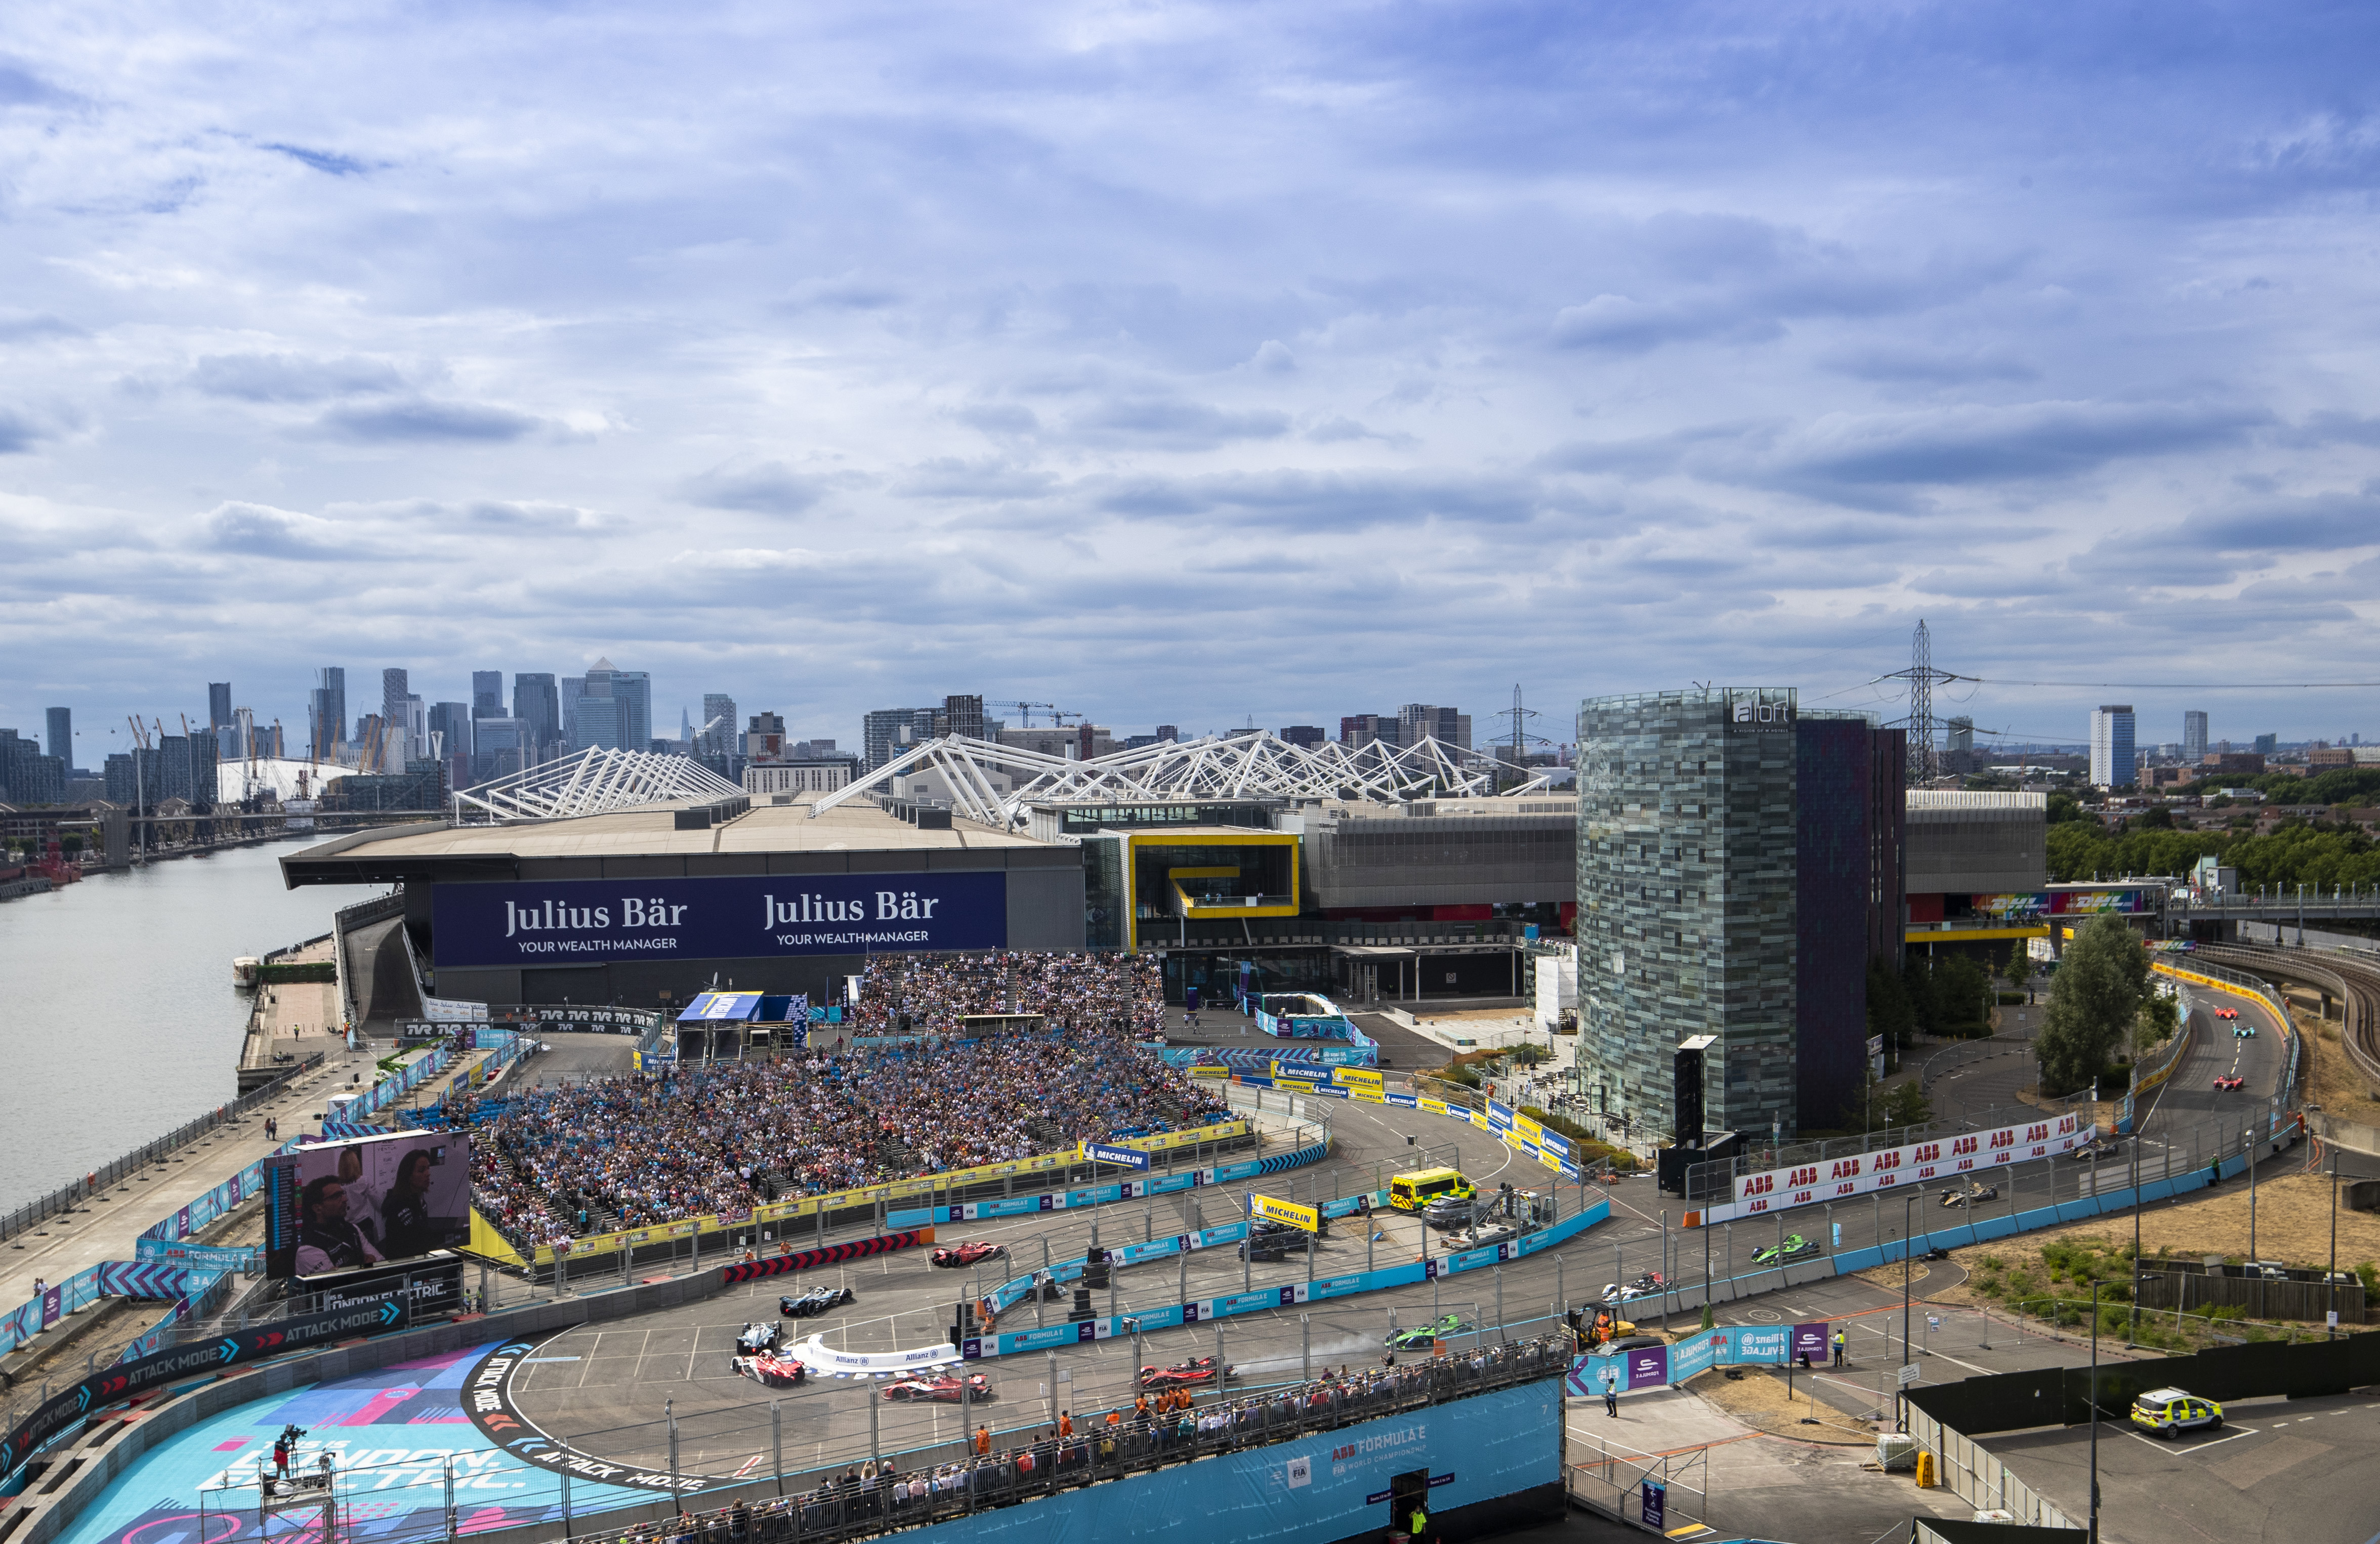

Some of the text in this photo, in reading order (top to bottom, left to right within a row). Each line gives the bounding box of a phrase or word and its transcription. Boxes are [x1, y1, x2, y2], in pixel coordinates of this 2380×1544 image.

[1733, 700, 1788, 722] aloft
[1990, 897, 2041, 910] DHL
[2075, 895, 2125, 908] DHL
[764, 891, 939, 930] Julius Bär
[506, 898, 687, 937] Julius Bär
[777, 931, 929, 946] YOUR WEALTH MANAGER
[519, 938, 677, 953] YOUR WEALTH MANAGER
[540, 1010, 564, 1020] TVR
[567, 1011, 589, 1021] TVR
[592, 1011, 611, 1022] TVR
[615, 1013, 631, 1023] TVR
[633, 1014, 645, 1025] TVR
[406, 1024, 432, 1035] TVR
[437, 1024, 462, 1035] TVR
[620, 1026, 631, 1034] TVR
[1287, 1068, 1327, 1078] MICHELIN
[1344, 1075, 1381, 1085] MICHELIN
[1451, 1109, 1469, 1119] MICHELIN
[1492, 1109, 1511, 1124] MICHELIN
[1474, 1117, 1485, 1126] MICHELIN
[2059, 1116, 2075, 1135] ABB
[1489, 1125, 1502, 1135] MICHELIN
[1518, 1124, 1538, 1138] MICHELIN
[2026, 1124, 2049, 1143] ABB
[1507, 1135, 1519, 1145] MICHELIN
[1952, 1136, 1978, 1156] ABB
[1990, 1130, 2014, 1149] ABB
[2063, 1139, 2073, 1150] ABB
[1524, 1142, 1538, 1155] MICHELIN
[1546, 1138, 1568, 1155] MICHELIN
[2032, 1146, 2045, 1156] ABB
[1097, 1150, 1143, 1165] MICHELIN
[1913, 1143, 1940, 1164] ABB
[1995, 1152, 2010, 1164] ABB
[1543, 1154, 1558, 1167] MICHELIN
[1873, 1151, 1901, 1172] ABB
[1957, 1159, 1973, 1171] ABB
[1563, 1167, 1578, 1178] MICHELIN
[1831, 1159, 1860, 1180] ABB
[1918, 1167, 1935, 1179] ABB
[1788, 1167, 1818, 1188] ABB
[1878, 1174, 1895, 1187] ABB
[1743, 1175, 1774, 1197] ABB
[1837, 1182, 1854, 1195] ABB
[1794, 1191, 1812, 1204] ABB
[1749, 1199, 1768, 1213] ABB
[1266, 1205, 1311, 1223] MICHELIN
[1468, 1252, 1486, 1261] FORMULA
[1332, 1278, 1355, 1287] FORMULA
[1238, 1295, 1263, 1303] FORMULA
[1138, 1313, 1164, 1321] FORMULA
[285, 1310, 378, 1342] ATTACK MODE
[1098, 1324, 1108, 1333] FIA
[1015, 1334, 1027, 1342] ABB
[1029, 1330, 1058, 1340] FORMULA
[836, 1356, 858, 1364] Allianz
[906, 1353, 929, 1361] Allianz
[129, 1347, 218, 1385] ATTACK MODE
[473, 1358, 512, 1412] ATTACK MODE
[1541, 1404, 1548, 1415] 7
[29, 1397, 78, 1440] ATTACK MODE
[263, 1441, 351, 1449] TIS IS
[1332, 1426, 1426, 1462] ABB FORMULA E
[1333, 1444, 1427, 1475] FIA WORLD CHAMPIONSHIP
[534, 1451, 708, 1491] ATTACK MODE
[1293, 1466, 1307, 1478] FIA
